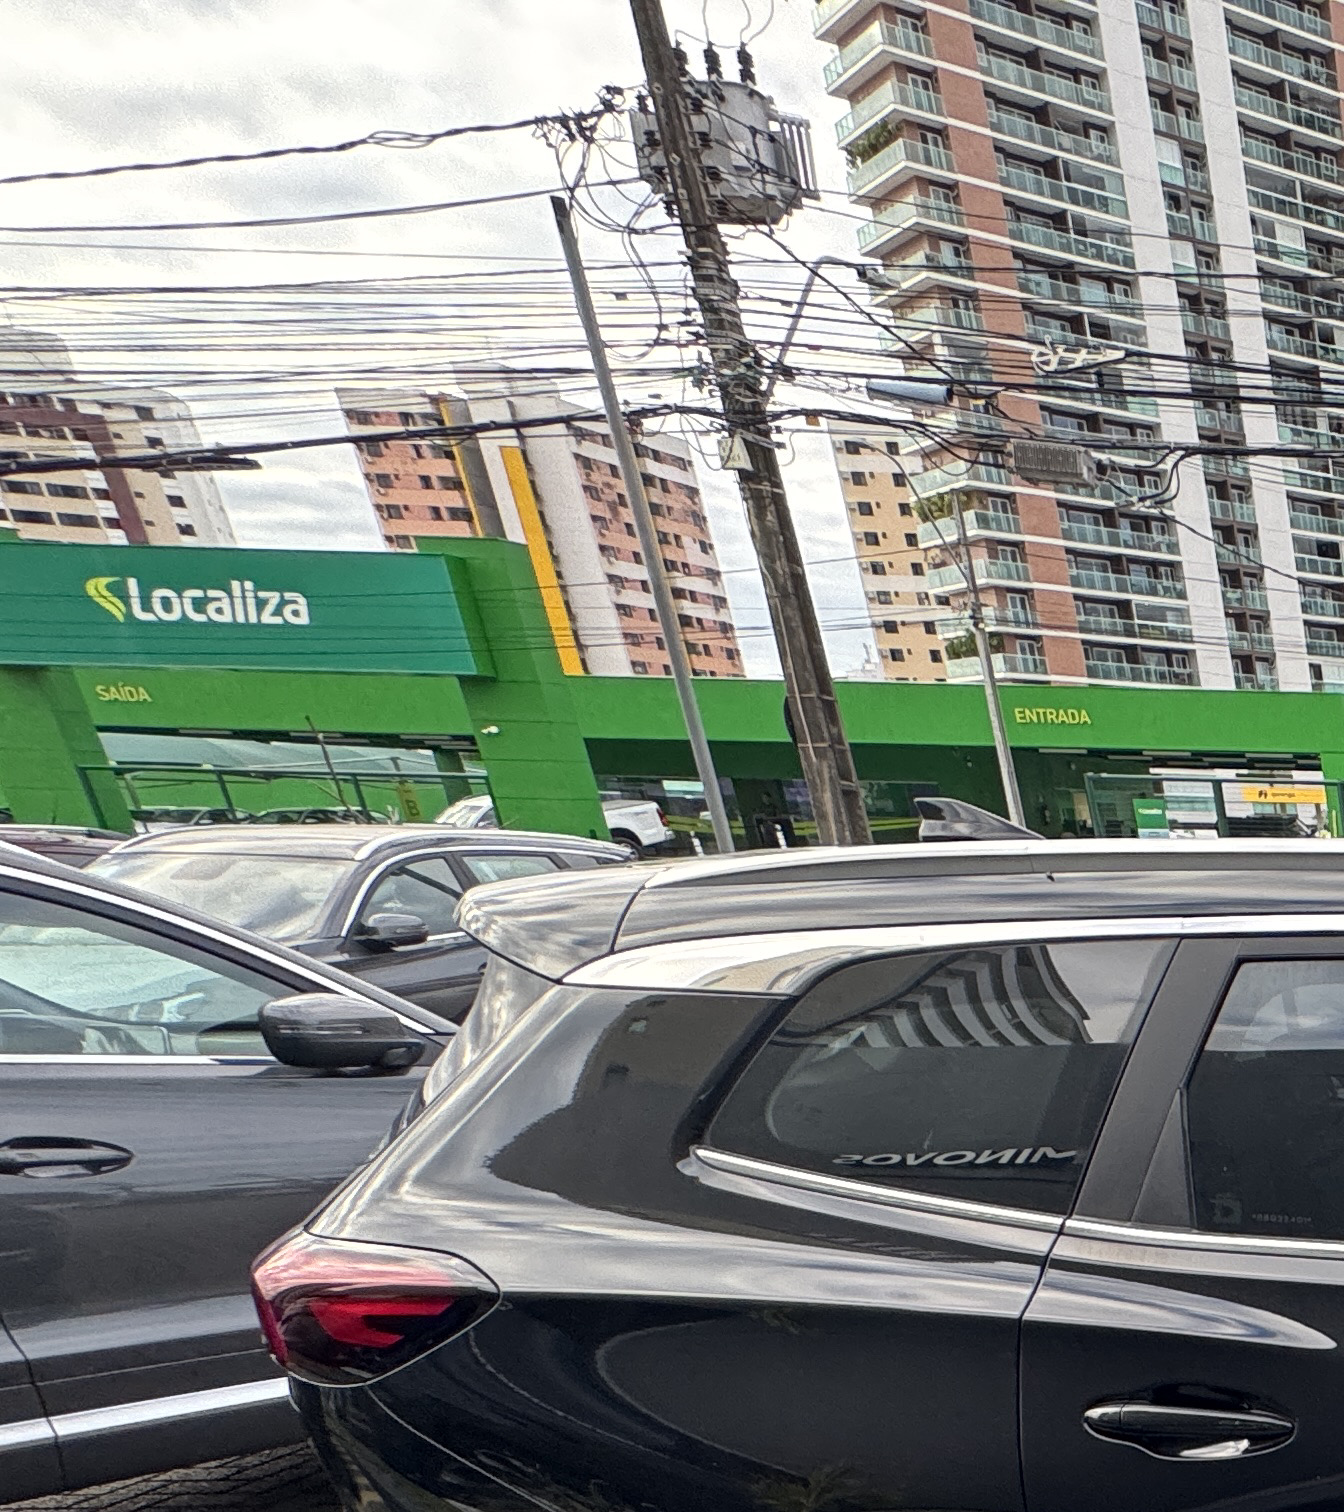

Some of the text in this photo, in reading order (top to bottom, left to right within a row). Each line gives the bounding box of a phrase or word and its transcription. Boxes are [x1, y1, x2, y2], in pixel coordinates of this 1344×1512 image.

[125, 577, 311, 625] Localiza
[95, 682, 153, 703] SAÍDA
[1014, 707, 1092, 725] ENTRADA
